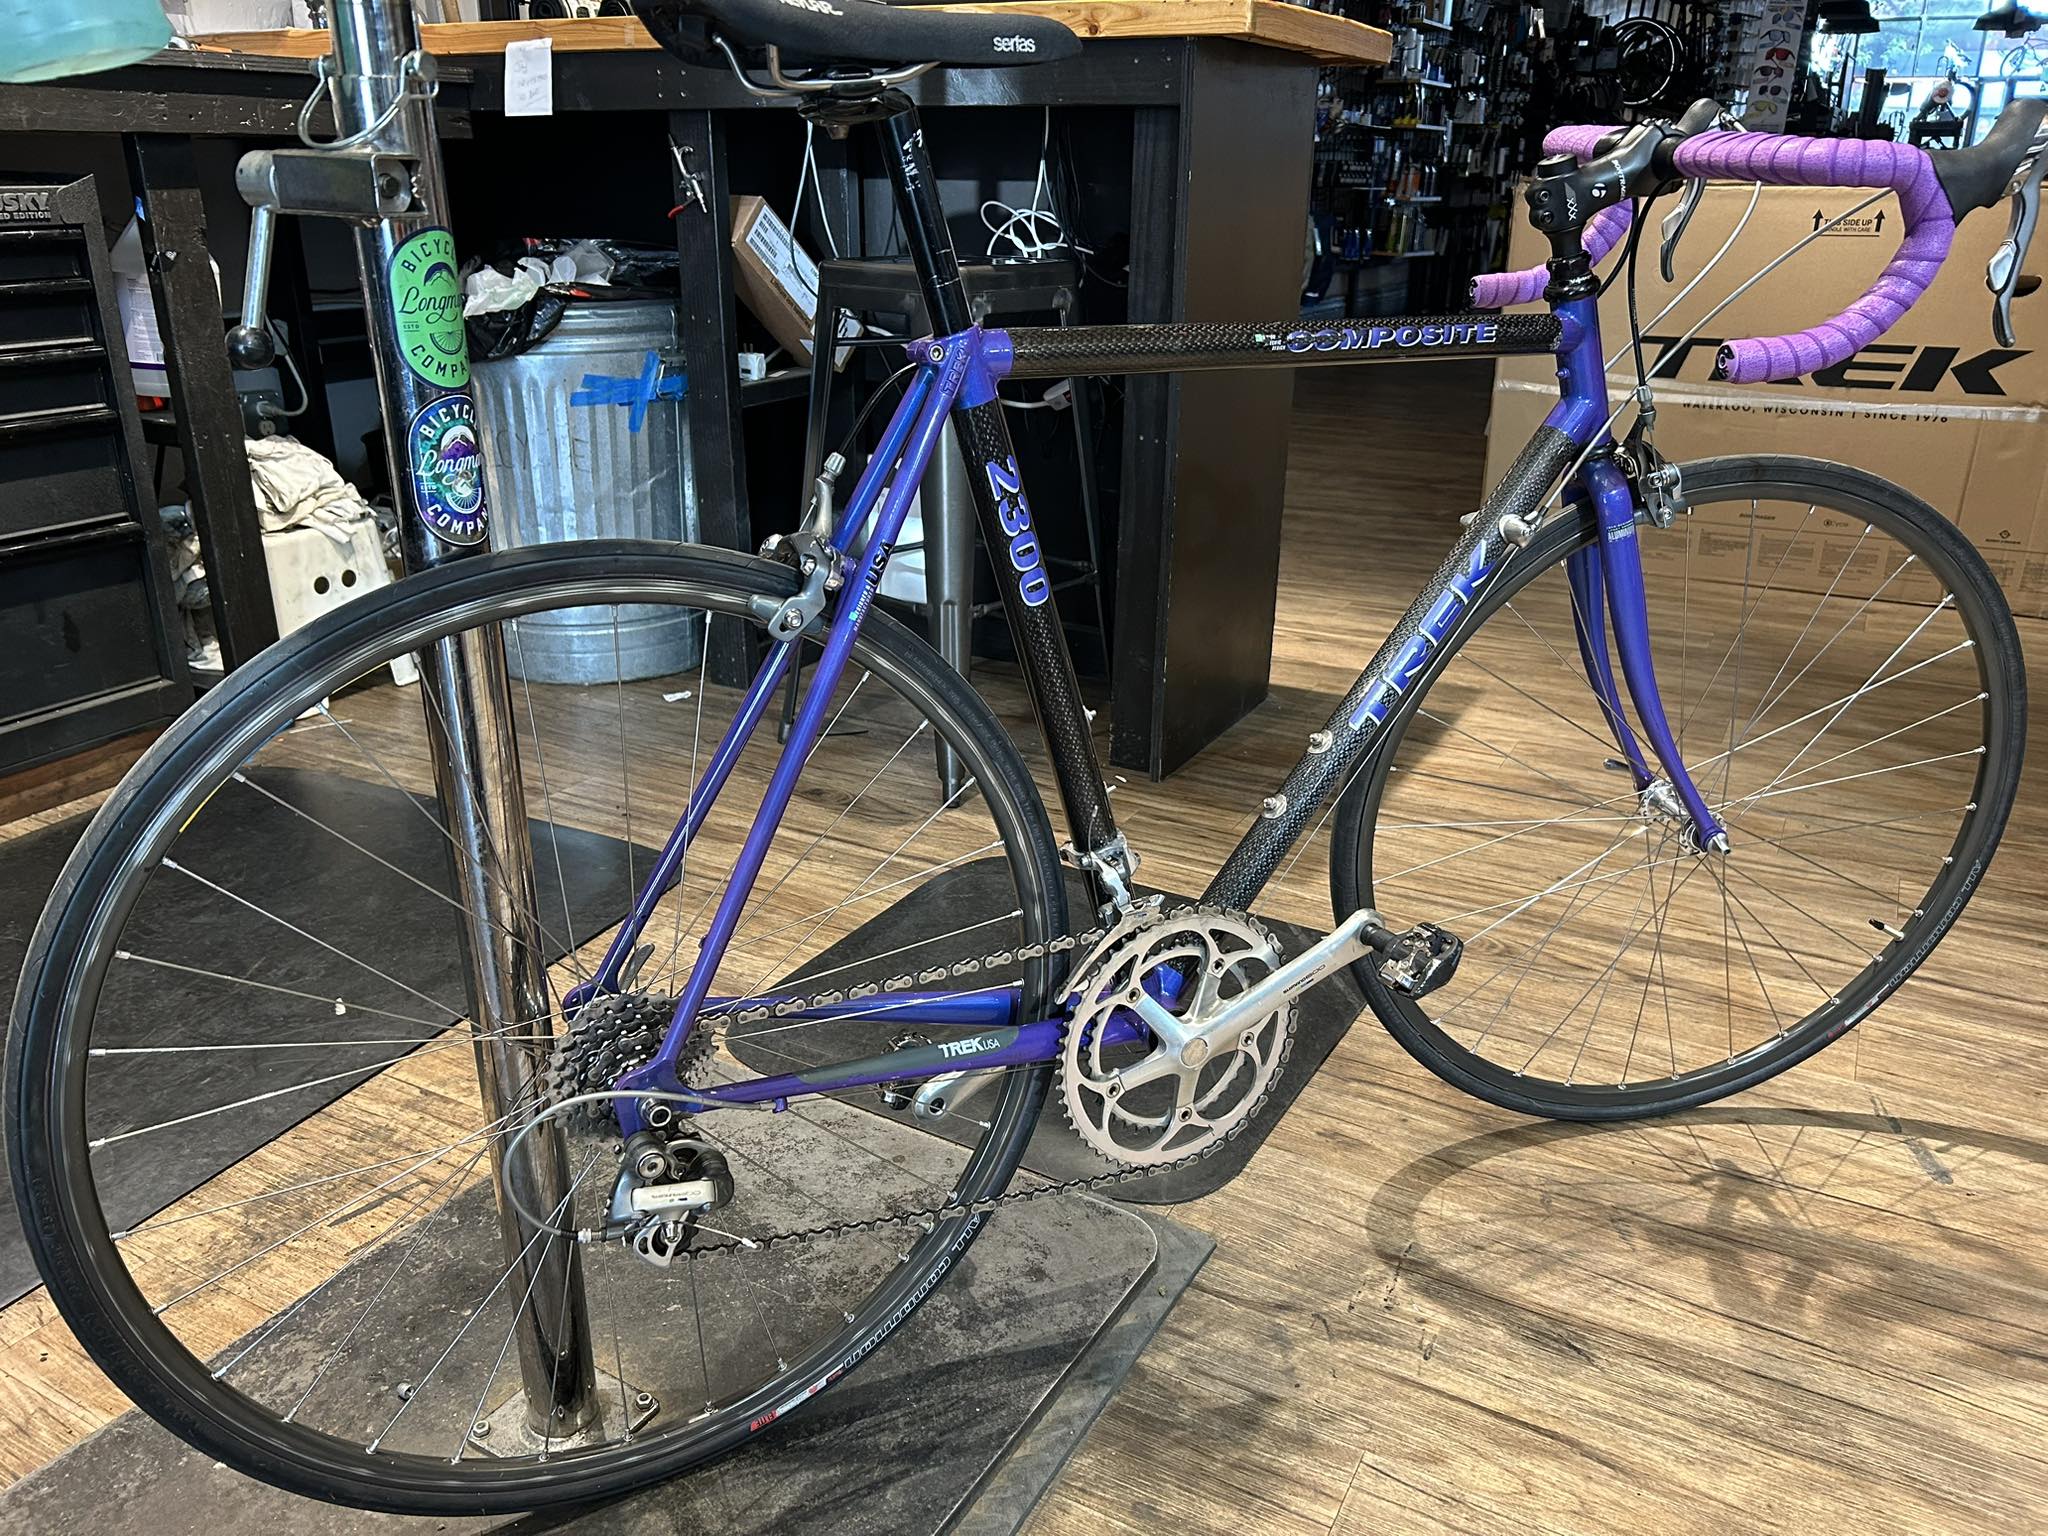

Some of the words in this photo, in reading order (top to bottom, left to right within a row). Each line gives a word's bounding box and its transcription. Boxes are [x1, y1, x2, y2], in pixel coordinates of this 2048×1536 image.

[993, 35, 1036, 52] serfas
[0, 192, 50, 212] SKY
[13, 211, 52, 220] EDITION
[1566, 198, 1578, 221] XXX
[1843, 219, 1860, 227] SIDE
[1861, 219, 1873, 227] UP
[400, 286, 461, 325] Longm
[1287, 323, 1498, 352] COMPOSITE
[411, 344, 469, 378] COMPA
[1640, 335, 2034, 396] TEK
[985, 454, 1049, 607] 2300
[865, 542, 893, 587] USA
[1349, 539, 1496, 731] TREK
[938, 1037, 984, 1058] TREK
[983, 1038, 1000, 1050] USA
[952, 1211, 981, 1251] ALL
